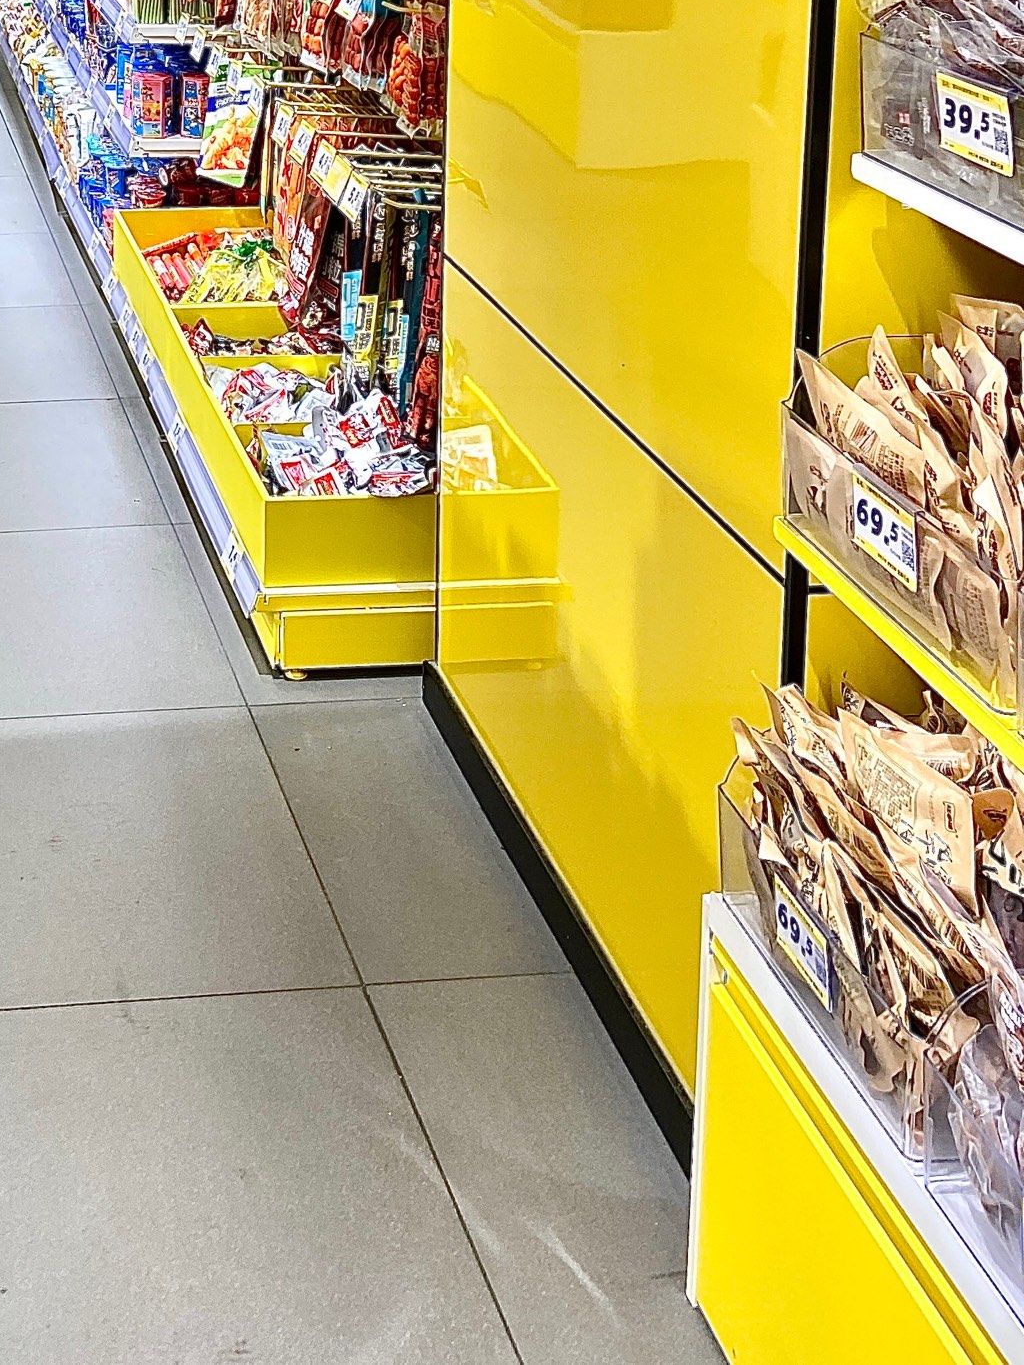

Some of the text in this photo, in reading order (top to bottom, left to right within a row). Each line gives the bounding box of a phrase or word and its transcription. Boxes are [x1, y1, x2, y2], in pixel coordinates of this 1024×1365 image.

[943, 97, 990, 140] 39.5
[856, 498, 899, 547] 69.5
[777, 902, 813, 957] 69.5
